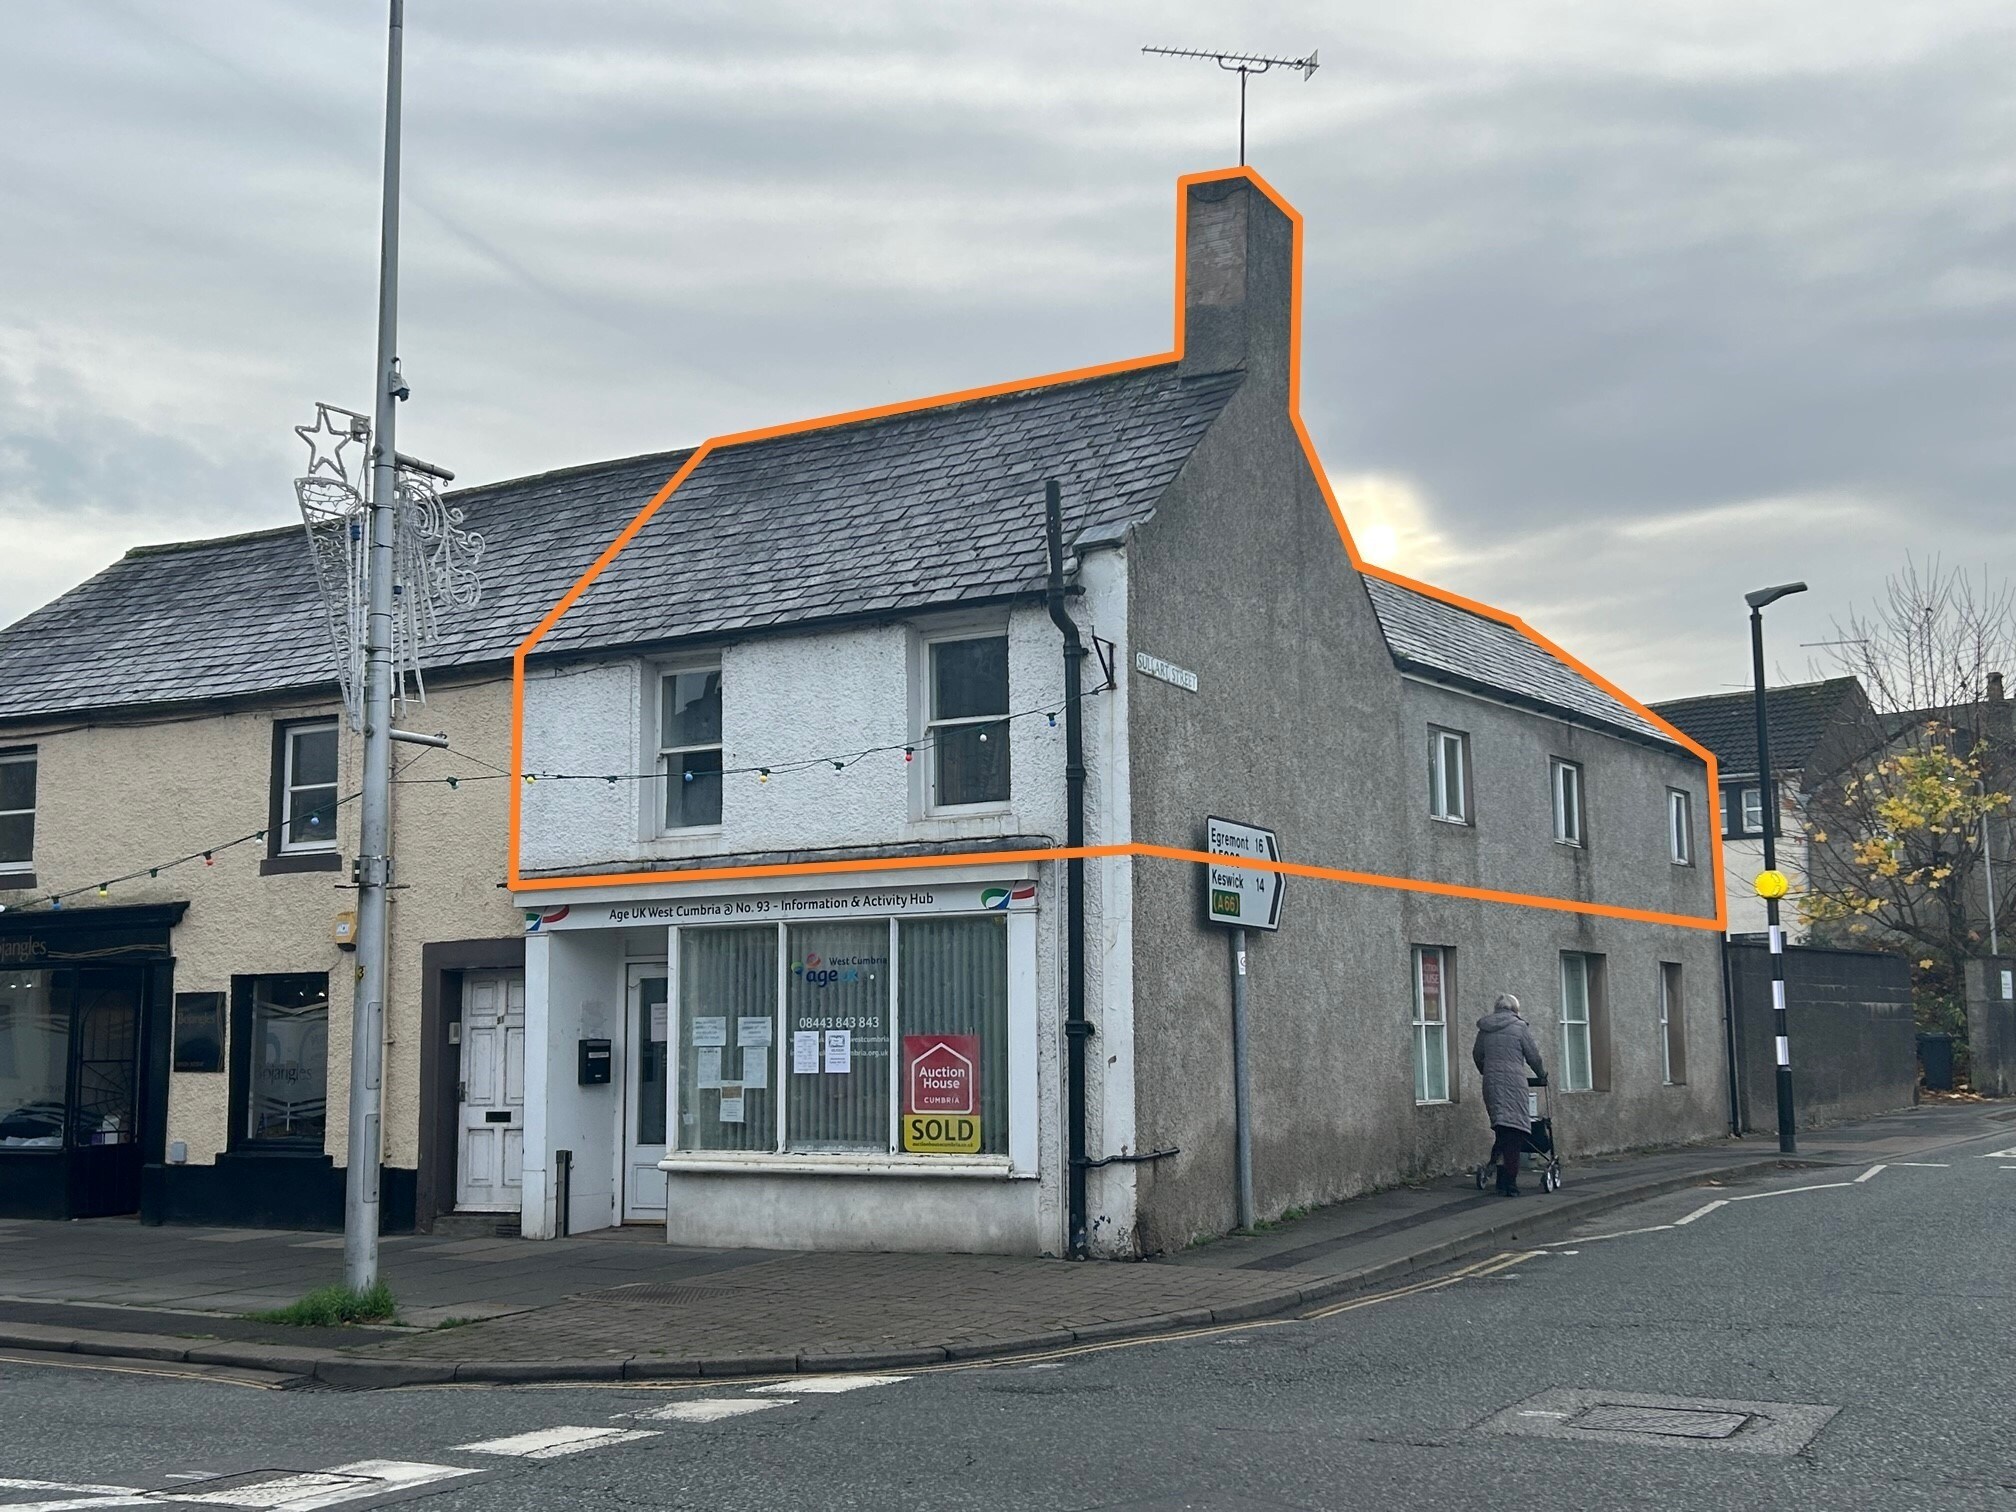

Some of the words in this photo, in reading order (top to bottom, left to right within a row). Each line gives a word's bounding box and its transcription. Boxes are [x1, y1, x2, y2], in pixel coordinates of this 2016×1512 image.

[1171, 667, 1197, 690] STREET
[1211, 827, 1249, 850] Egremont
[1255, 837, 1264, 853] 16
[1211, 868, 1244, 889] Keswick
[1256, 877, 1265, 892] 14
[609, 909, 629, 923] Age
[632, 907, 646, 919] UK
[649, 905, 673, 918] West
[676, 902, 721, 917] Cumbria
[724, 903, 733, 916] @
[736, 902, 754, 914] No.
[757, 900, 770, 913] 93
[781, 897, 848, 911] Information
[851, 895, 860, 908] &
[863, 894, 907, 909] Activity
[910, 892, 934, 905] Hub
[1213, 893, 1239, 915] (A66)
[829, 957, 850, 966] West
[851, 956, 887, 965] Cumbria
[799, 1018, 833, 1029] 08443
[835, 1017, 856, 1028] 843
[858, 1016, 879, 1027] 843
[919, 1066, 965, 1078] Auction
[923, 1078, 960, 1089] House
[924, 1096, 960, 1104] CUMBRIA
[911, 1119, 974, 1141] SOLD
